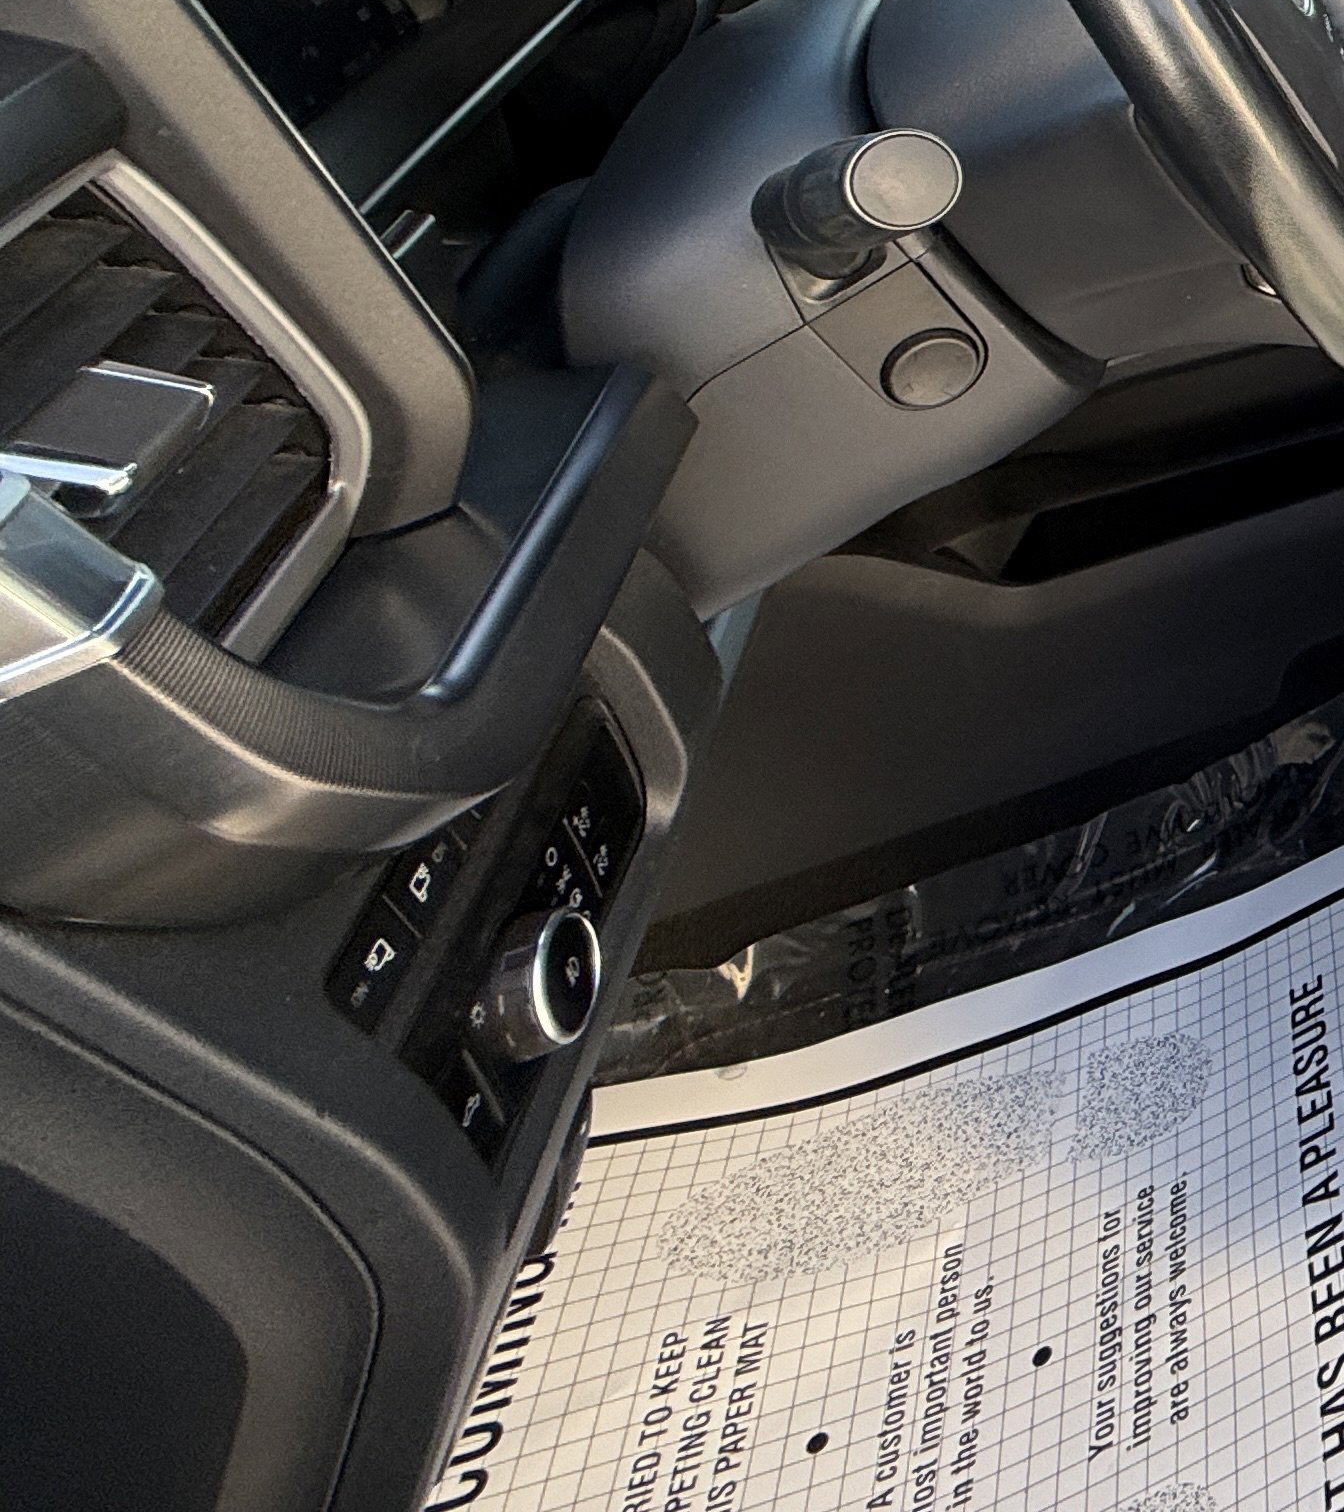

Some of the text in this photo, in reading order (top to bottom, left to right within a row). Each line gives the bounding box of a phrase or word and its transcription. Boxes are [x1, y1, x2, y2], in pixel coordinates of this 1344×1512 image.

[1289, 974, 1337, 1174] PLEASURE
[1302, 1169, 1341, 1208] A
[650, 1331, 689, 1400] KEEP
[689, 1315, 732, 1403] CLEAN
[734, 1321, 769, 1378] MAT
[913, 1327, 953, 1456] important
[936, 1242, 964, 1323] person
[1088, 1208, 1123, 1463] Your suggestions for
[1126, 1184, 1158, 1451] improving our service
[1164, 1171, 1192, 1426] are always welcome.
[638, 1406, 673, 1447] TO
[713, 1382, 757, 1475] PAPER
[866, 1329, 917, 1510] A customer is
[945, 1275, 995, 1512] in the world to us.
